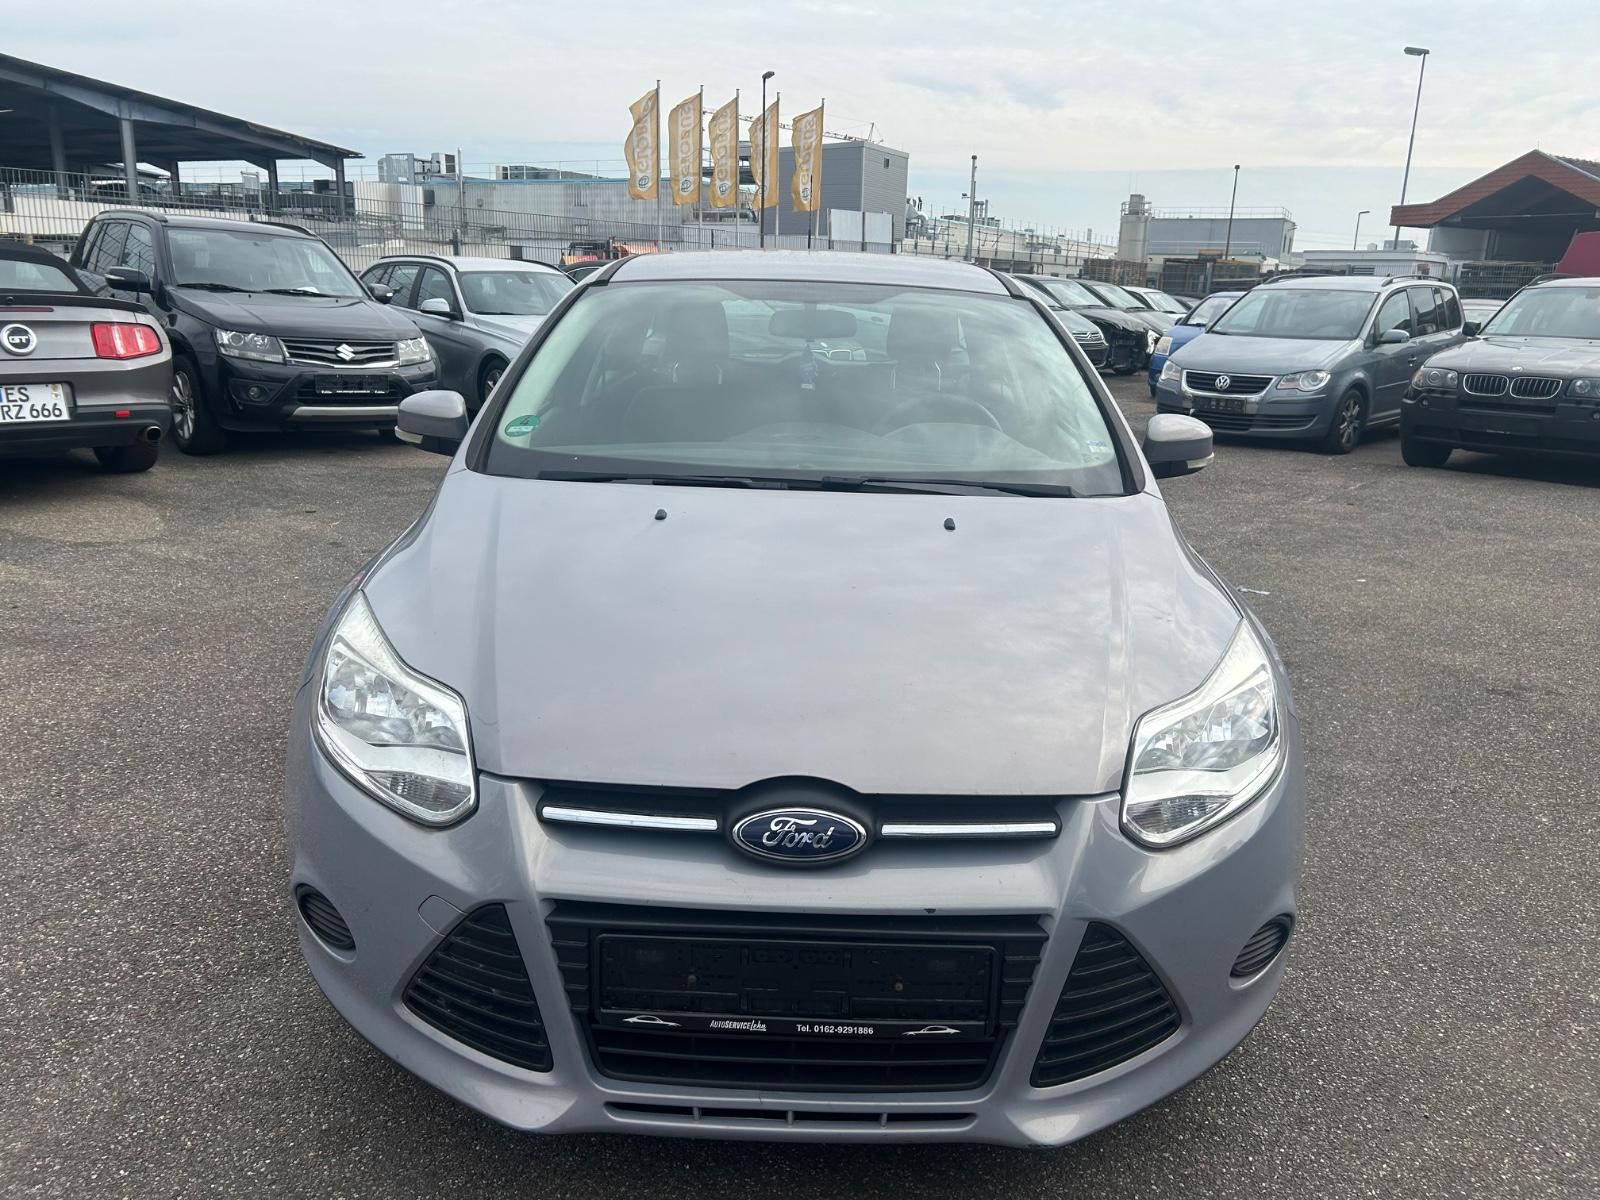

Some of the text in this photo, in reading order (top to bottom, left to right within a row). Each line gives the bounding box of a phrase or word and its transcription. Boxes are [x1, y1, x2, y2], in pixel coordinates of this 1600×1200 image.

[8, 336, 29, 344] GT
[4, 387, 30, 403] ES
[0, 402, 63, 420] RZ 666
[762, 816, 835, 849] Ford
